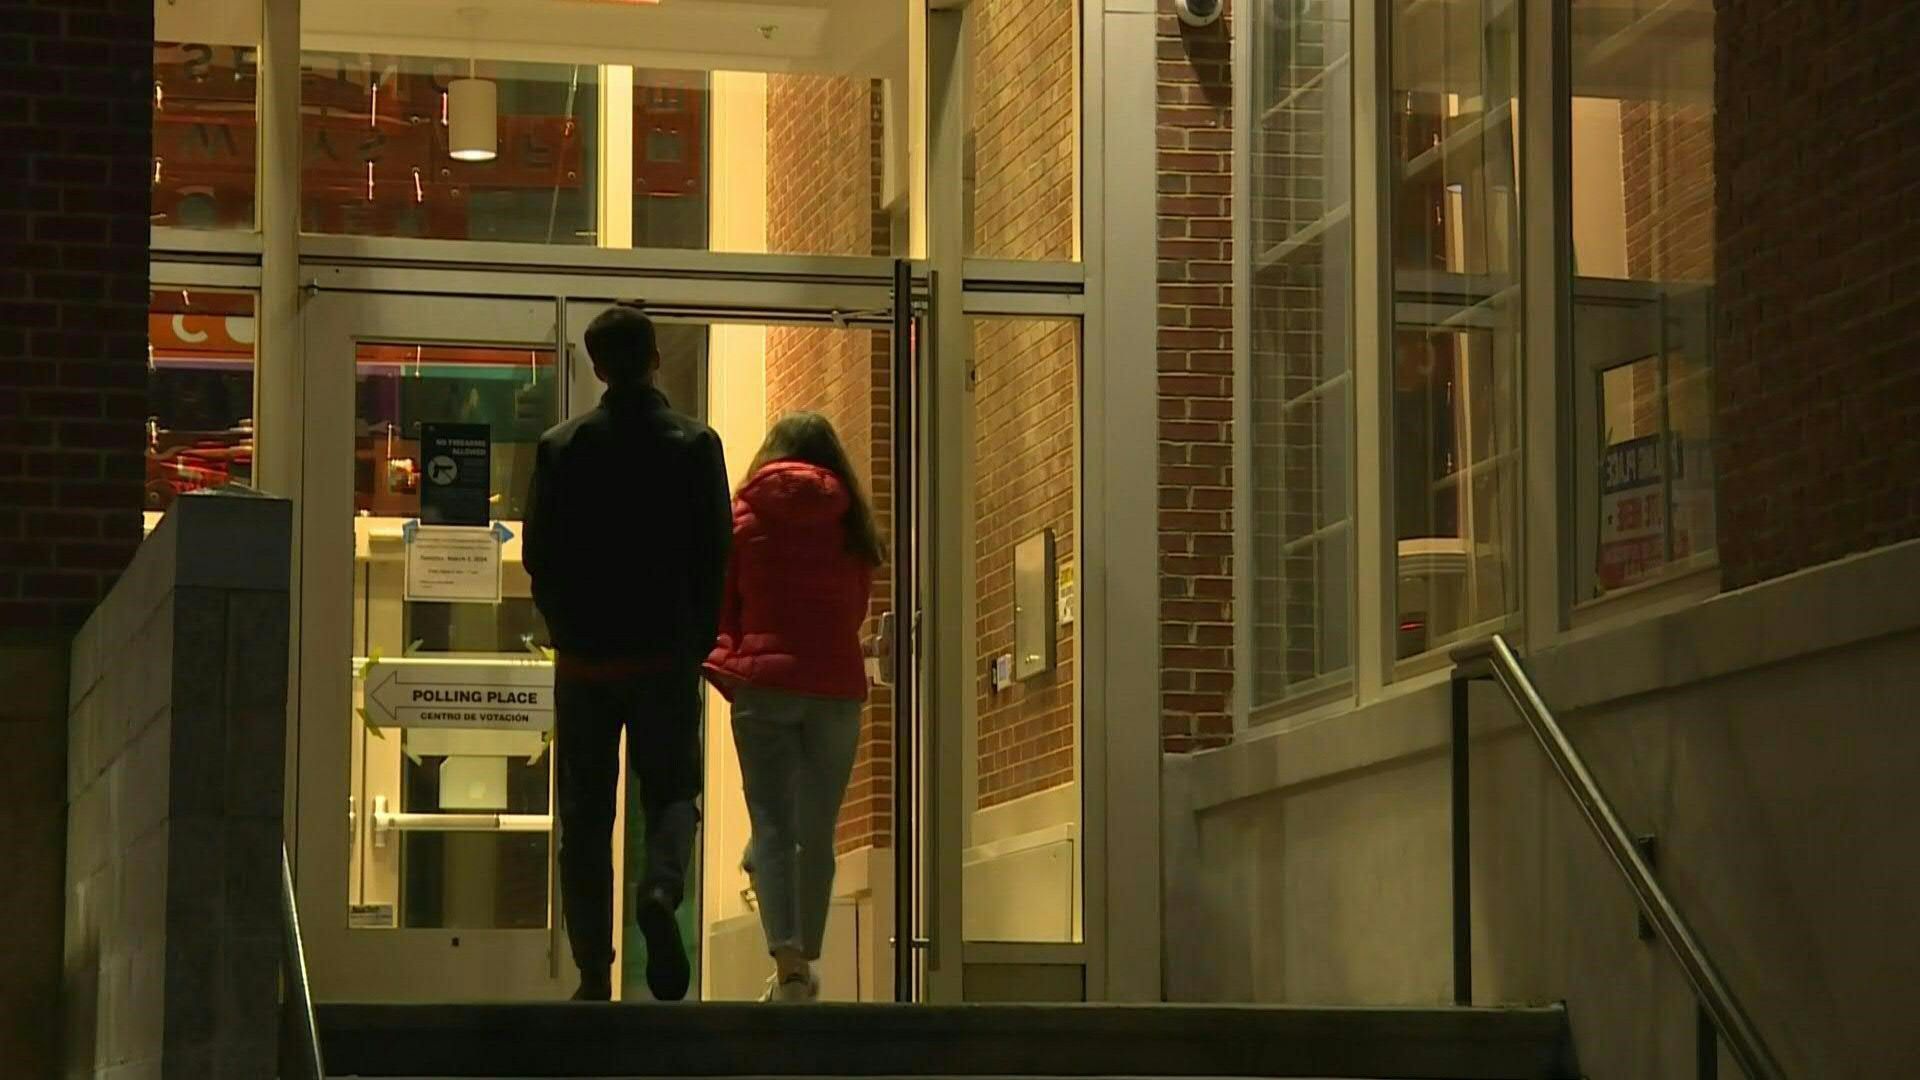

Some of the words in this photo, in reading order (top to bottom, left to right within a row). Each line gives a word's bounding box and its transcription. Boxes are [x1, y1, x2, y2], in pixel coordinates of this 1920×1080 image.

[412, 690, 482, 703] POLLING
[487, 691, 538, 704] PLACE
[420, 712, 461, 721] CENTRO
[463, 713, 477, 721] DE
[480, 712, 529, 722] VOTACIÓN
